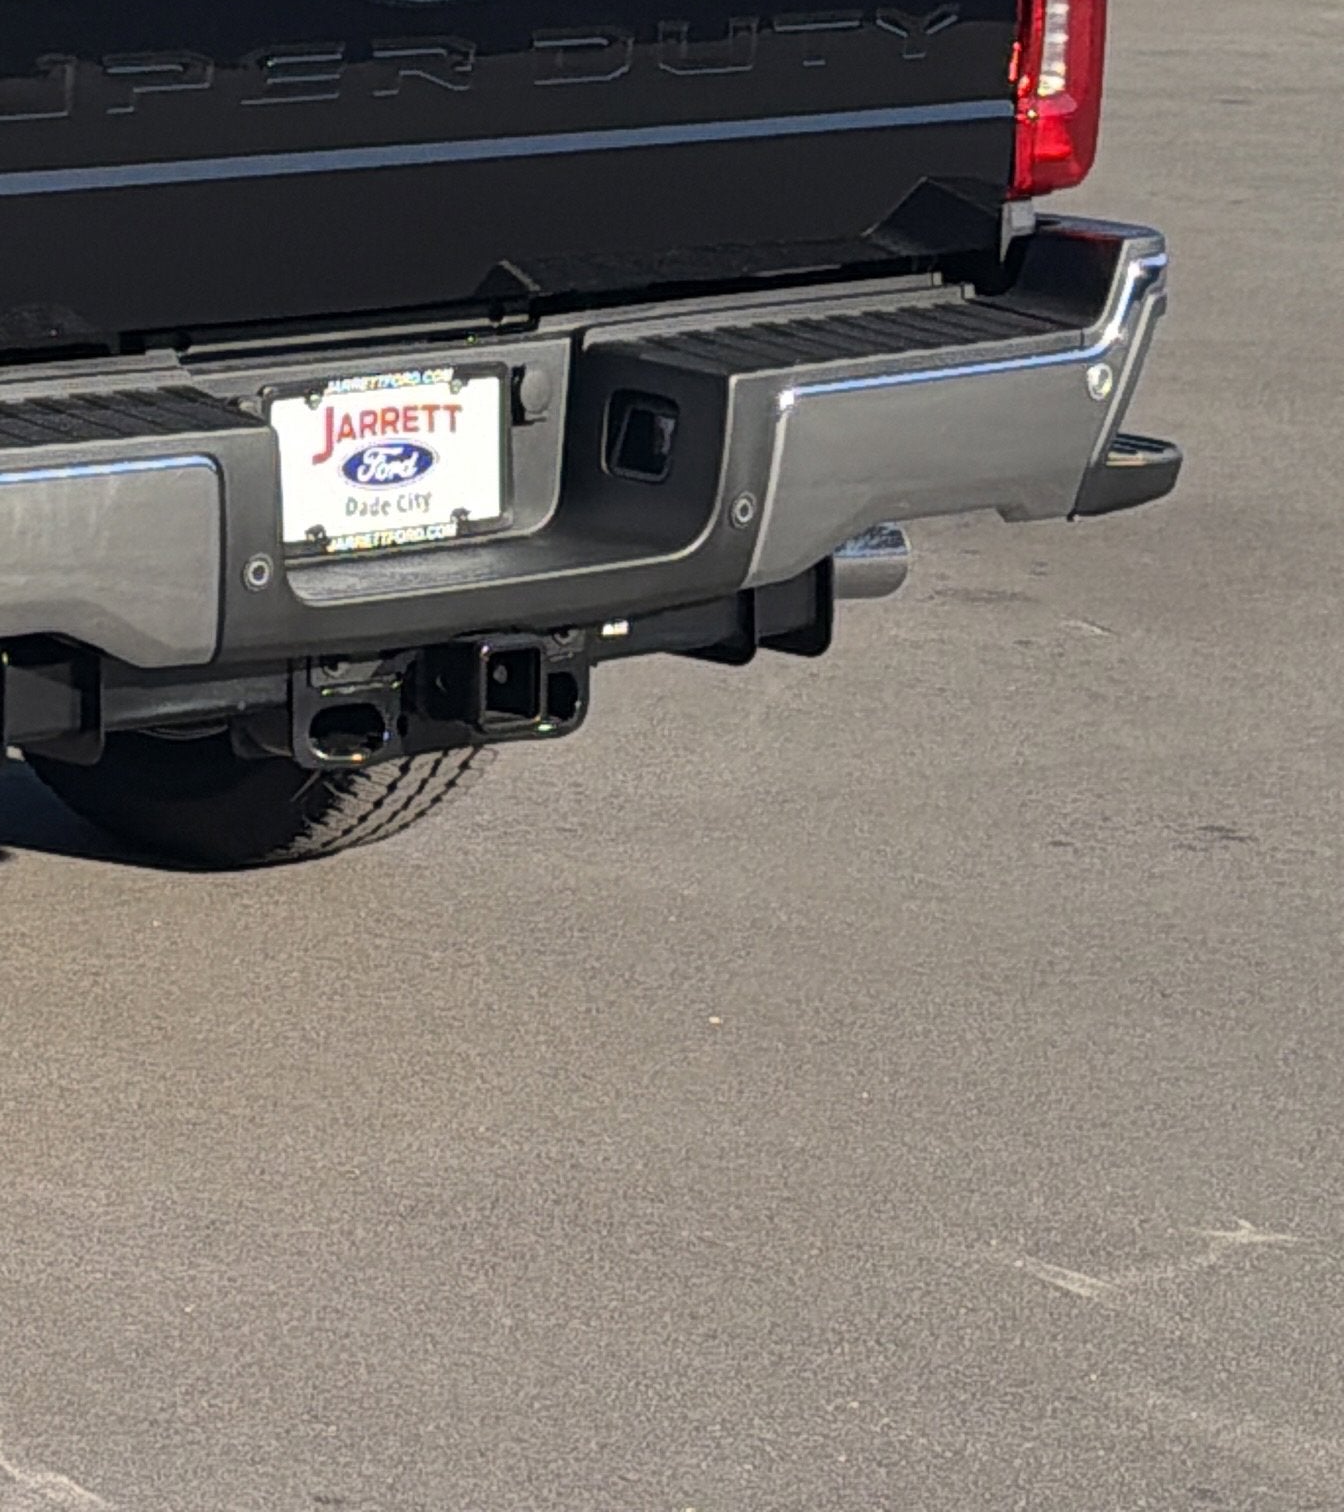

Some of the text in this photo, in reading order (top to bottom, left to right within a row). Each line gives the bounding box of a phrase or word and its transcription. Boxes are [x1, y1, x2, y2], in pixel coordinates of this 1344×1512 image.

[530, 1, 963, 87] DUTY
[312, 404, 463, 466] JARRETT
[356, 446, 420, 483] Ford
[345, 491, 432, 516] Dade City
